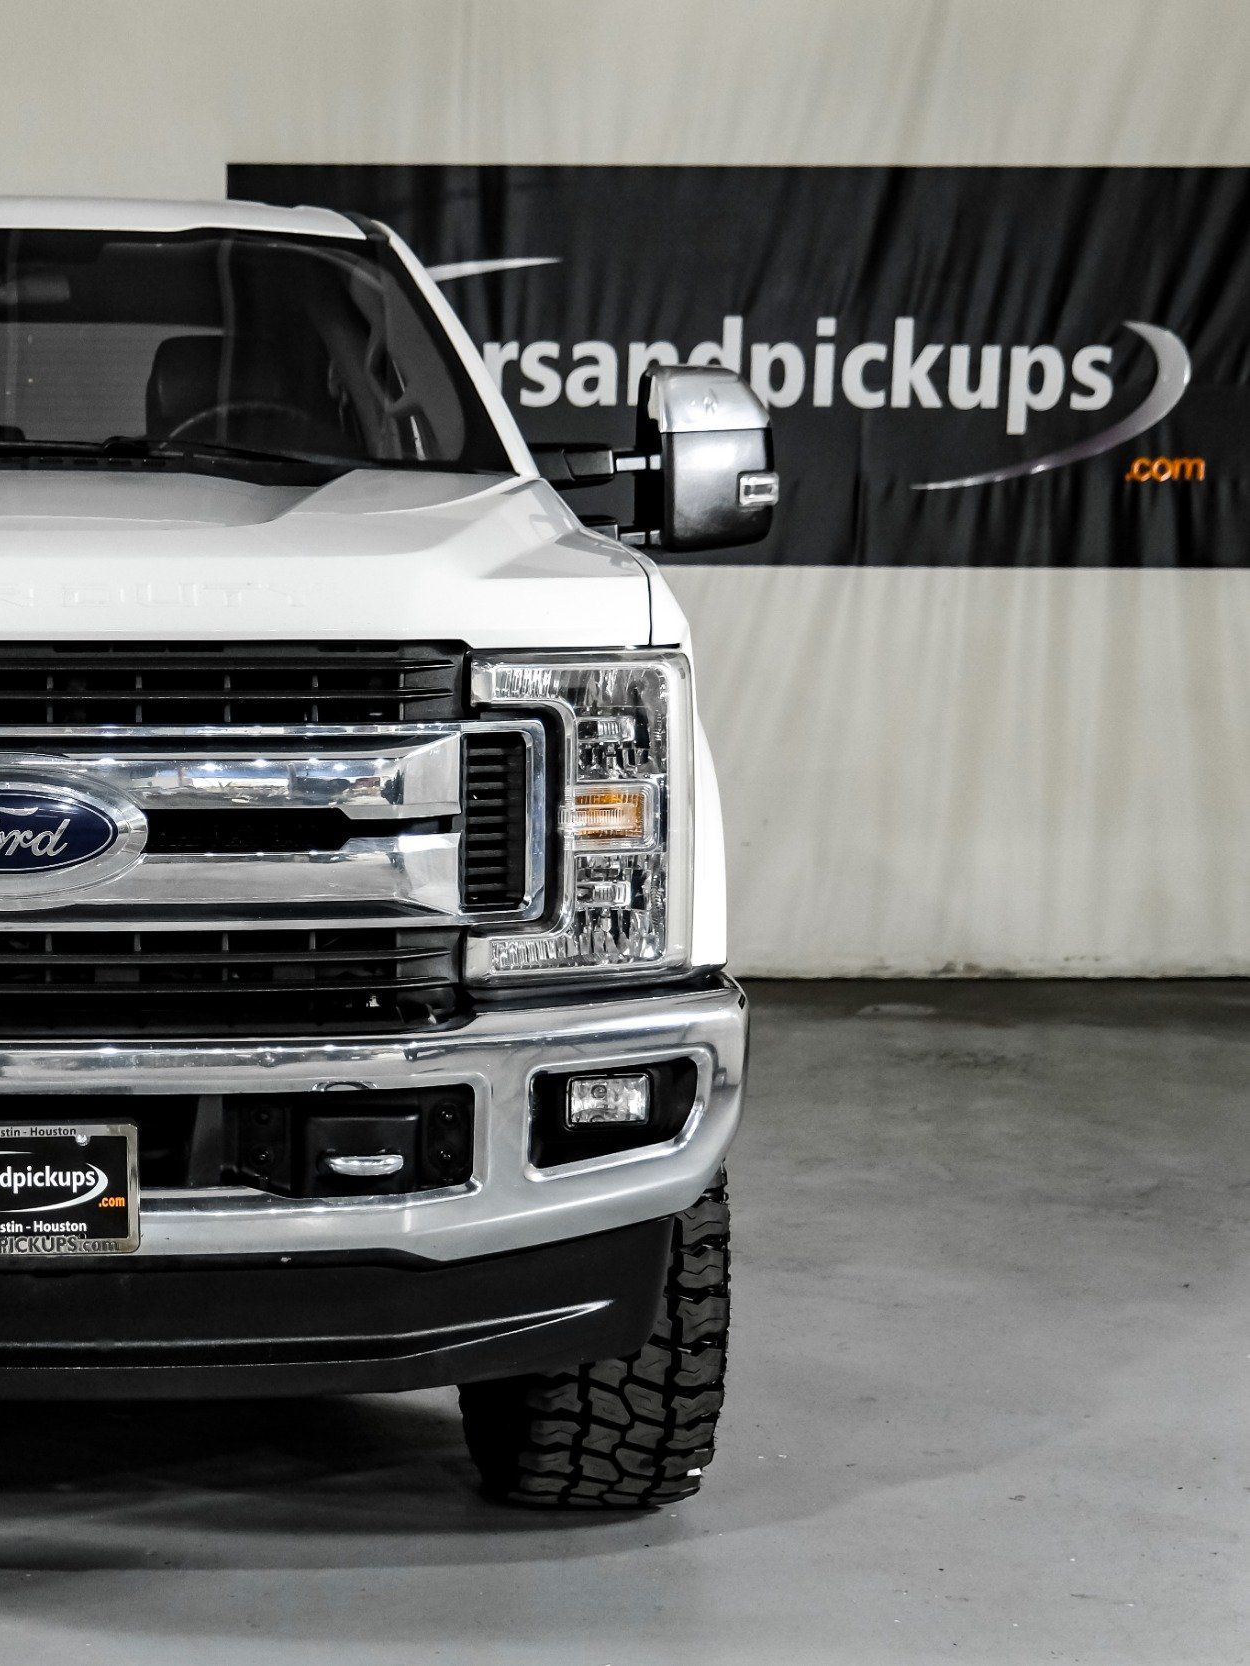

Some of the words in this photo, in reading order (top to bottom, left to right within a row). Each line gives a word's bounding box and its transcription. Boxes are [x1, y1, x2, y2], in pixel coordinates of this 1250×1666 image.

[1125, 456, 1206, 482] .com
[59, 581, 324, 608] DUTY
[30, 1126, 77, 1137] Houston
[98, 1196, 126, 1208] .com
[33, 1220, 88, 1233] Houston
